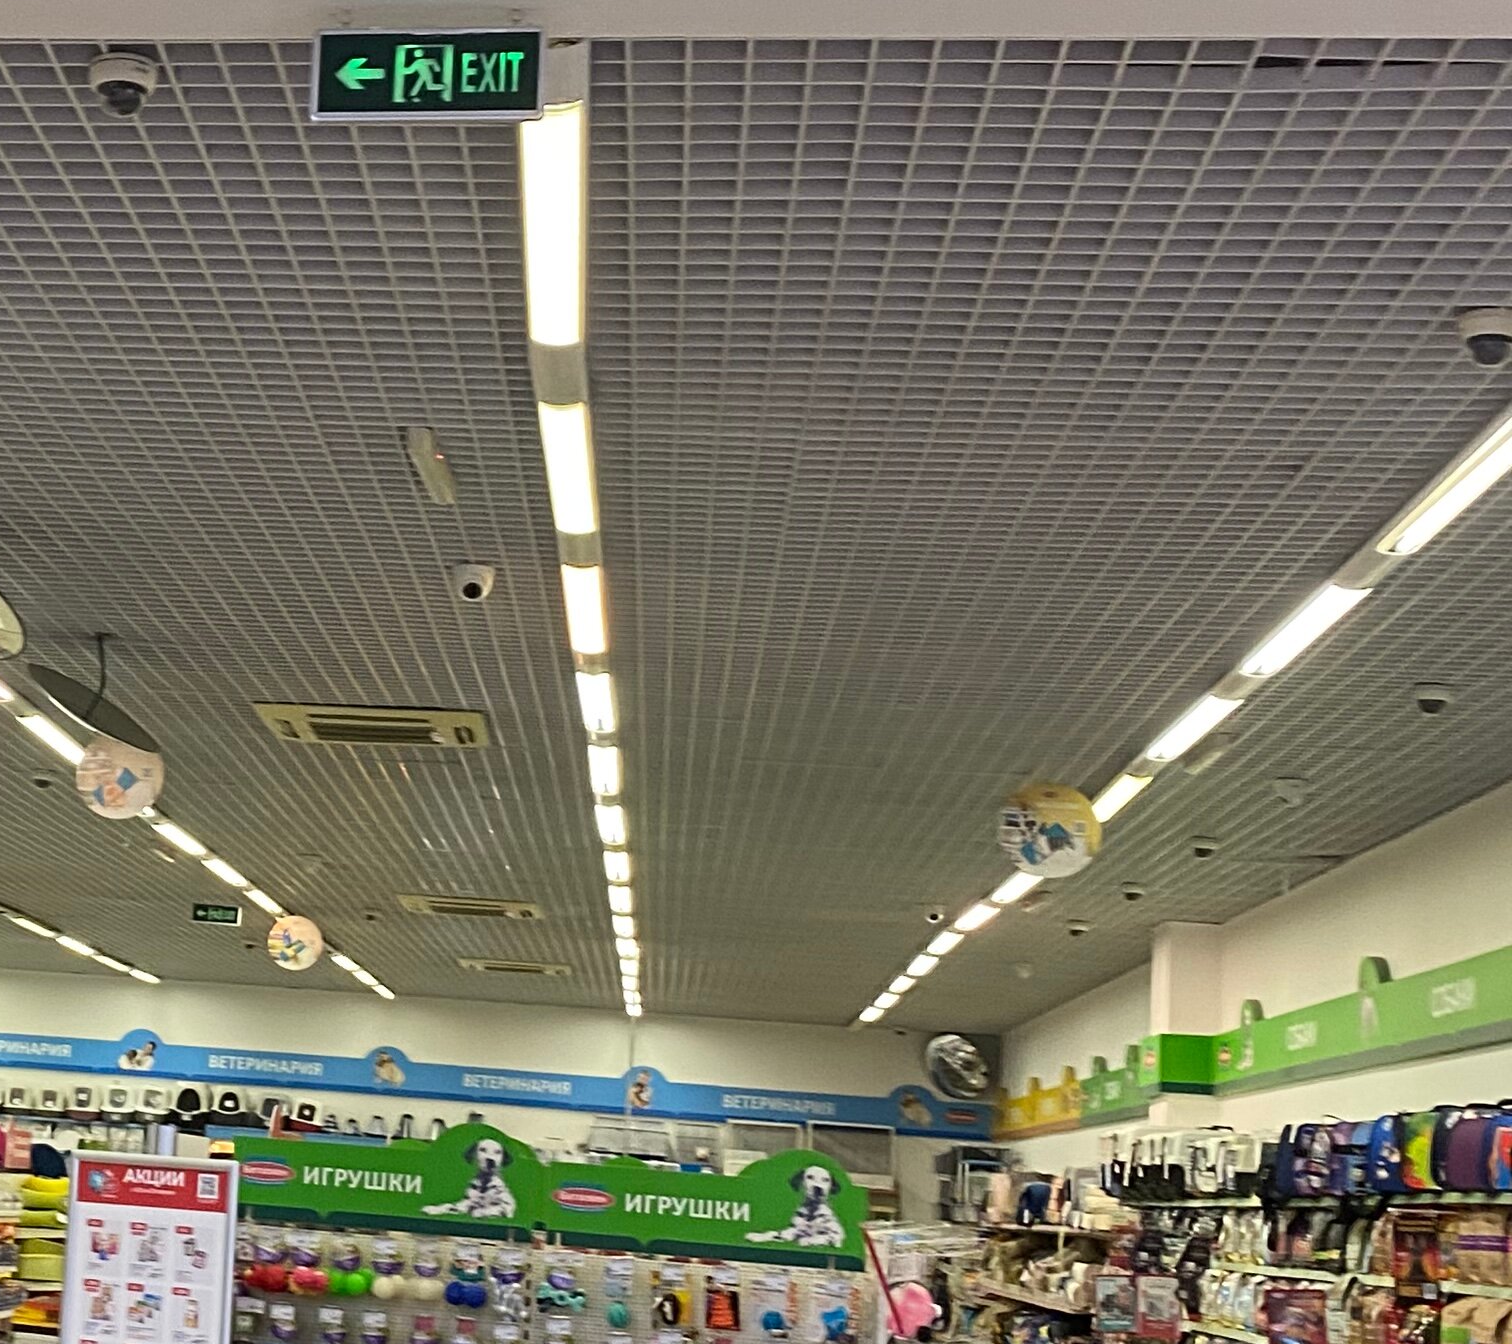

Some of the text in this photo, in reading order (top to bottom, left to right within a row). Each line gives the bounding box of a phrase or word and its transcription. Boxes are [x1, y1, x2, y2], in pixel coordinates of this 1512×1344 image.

[460, 51, 525, 93] EXIT
[208, 1054, 324, 1076] ВЕТЕРИНАРИЯ
[462, 1074, 572, 1096] ВЕТЕРИНАРИЯ
[722, 1094, 835, 1116] ВЕТЕРИНАРИЯ
[122, 1168, 186, 1187] АКЦИИ
[303, 1166, 423, 1194] ИГРУШКИ
[625, 1194, 751, 1223] ИГРУШКИ
